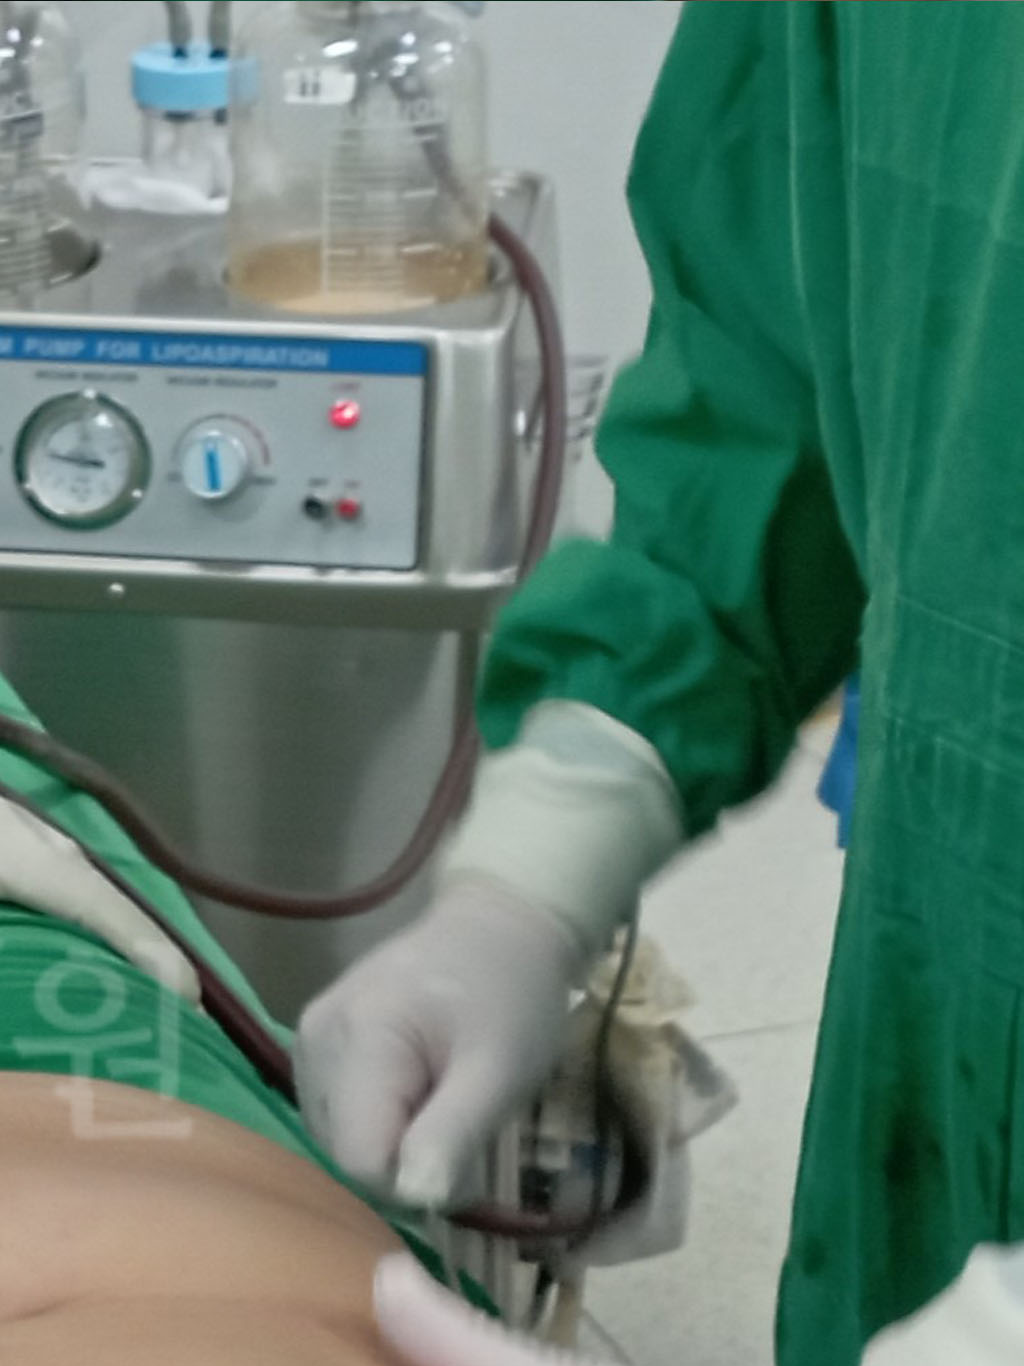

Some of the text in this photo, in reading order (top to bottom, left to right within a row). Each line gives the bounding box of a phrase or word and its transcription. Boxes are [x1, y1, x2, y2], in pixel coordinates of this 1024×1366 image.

[24, 337, 86, 358] PUMP
[96, 339, 141, 360] FOR
[150, 342, 329, 367] LIPOASPIRATION
